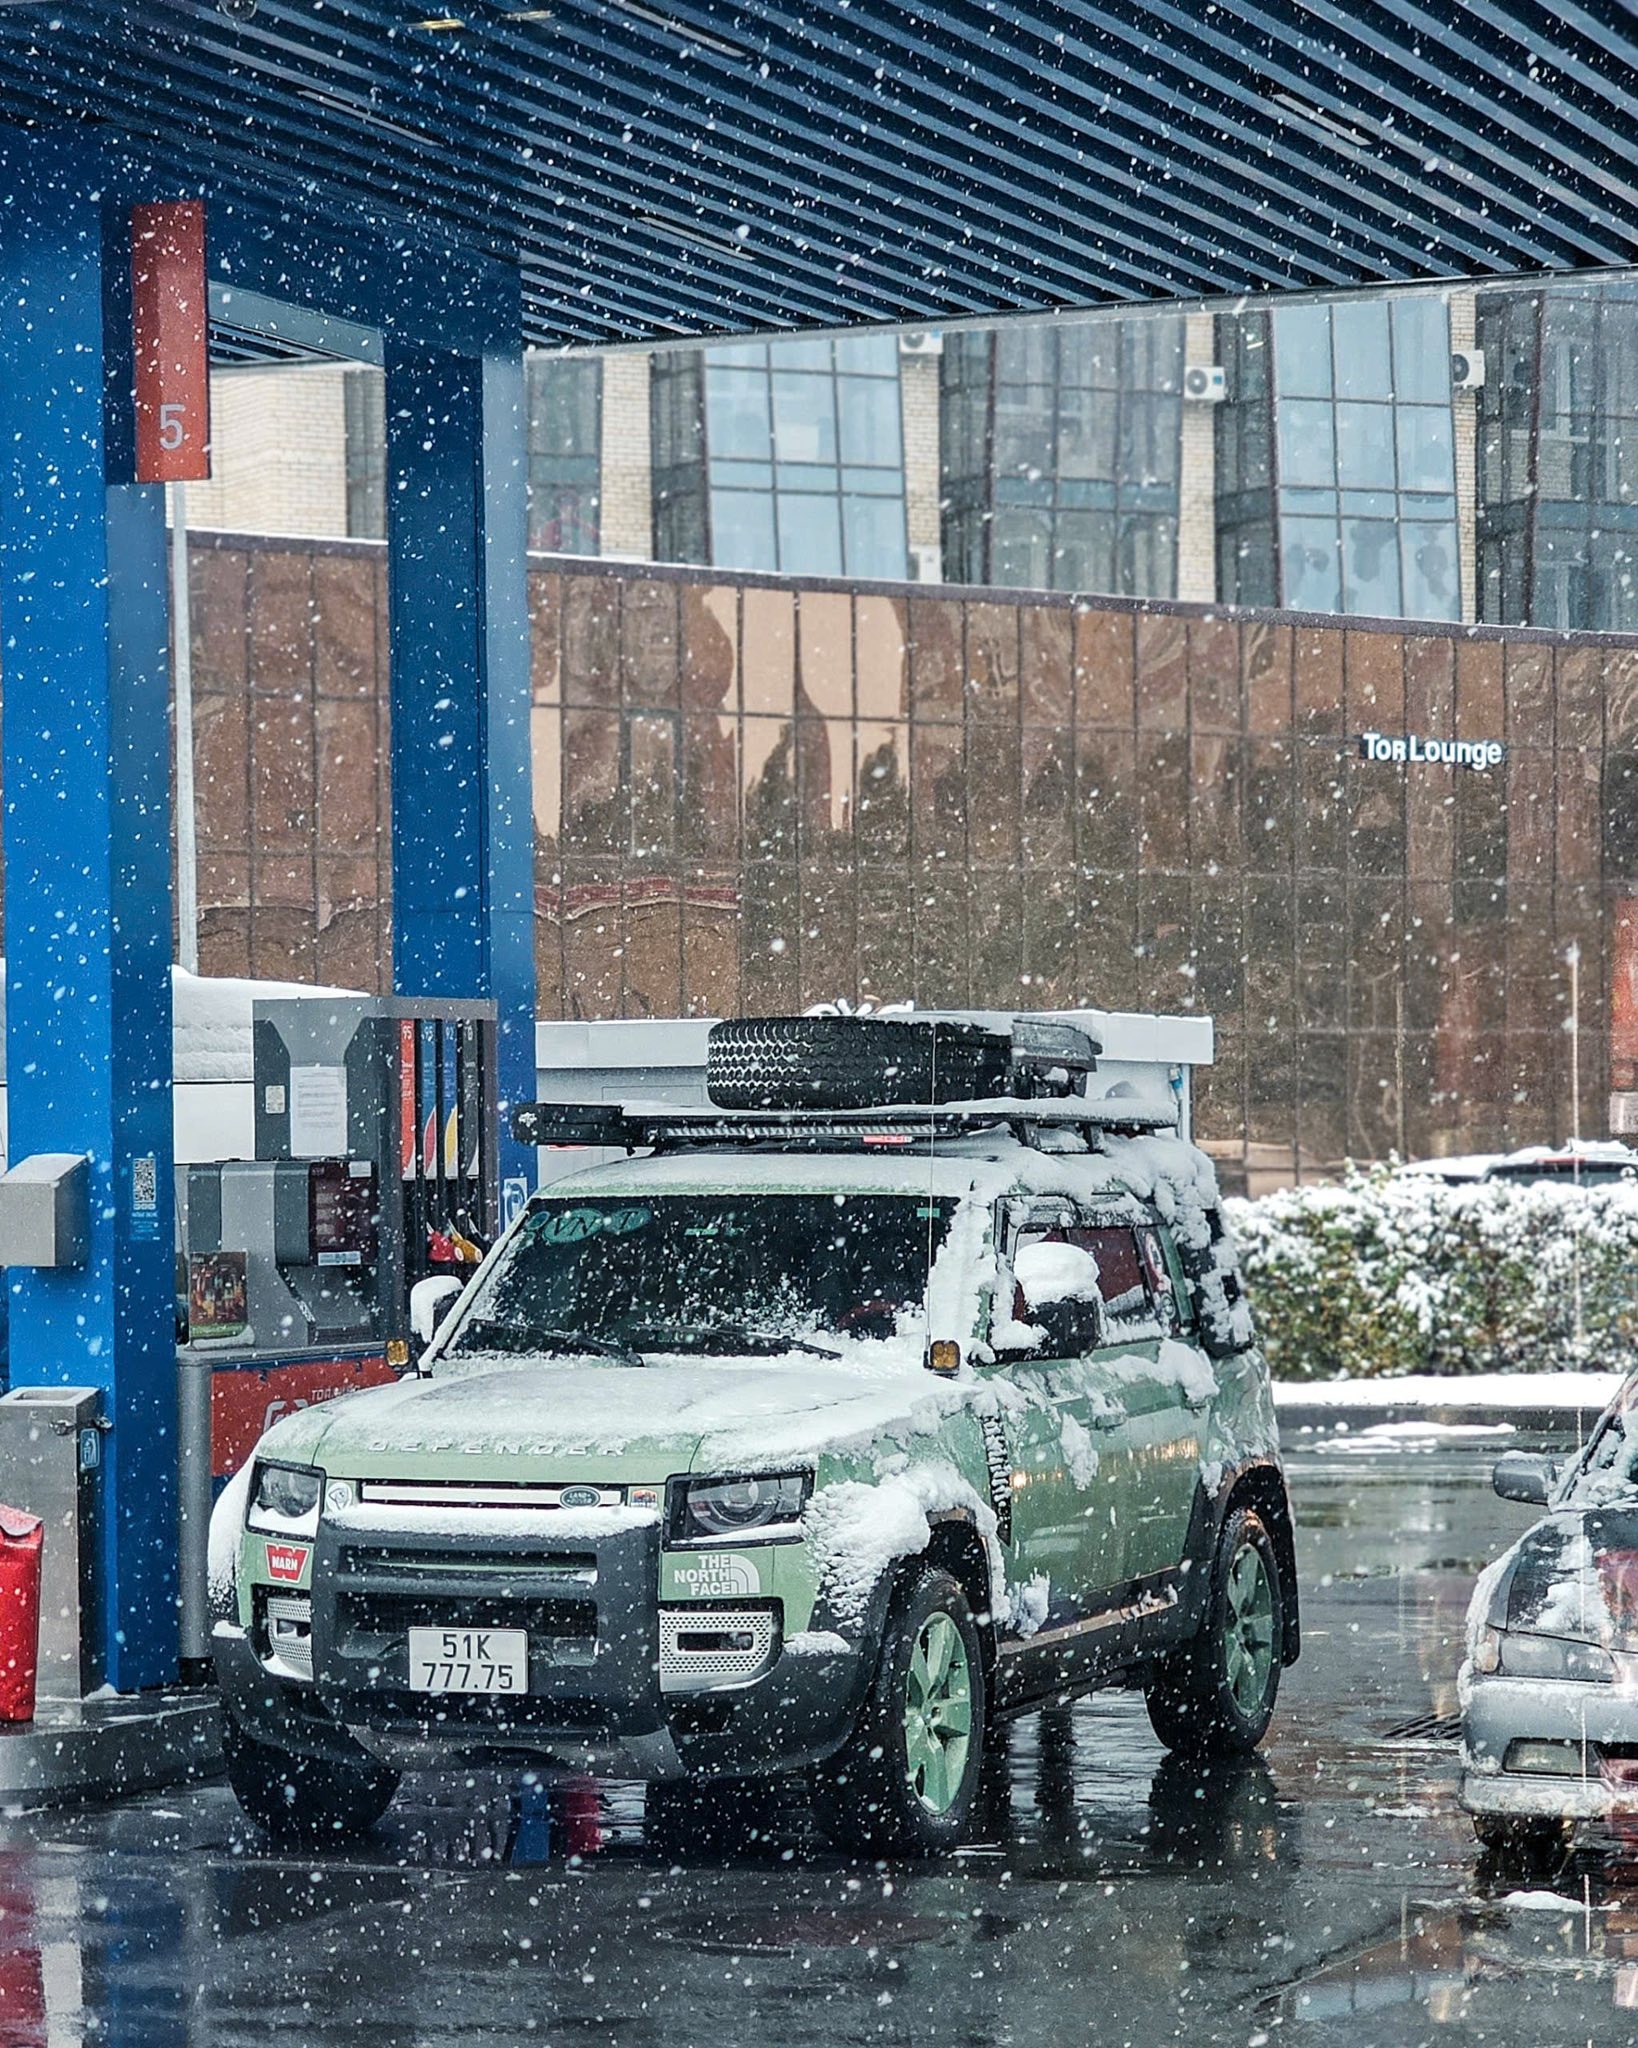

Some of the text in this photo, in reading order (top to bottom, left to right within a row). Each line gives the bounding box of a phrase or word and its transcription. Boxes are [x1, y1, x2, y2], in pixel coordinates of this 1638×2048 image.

[160, 403, 185, 450] 5
[1409, 735, 1502, 771] Lounge
[553, 1216, 599, 1237] VN
[271, 1555, 298, 1571] WARN
[698, 1554, 731, 1569] THE
[674, 1568, 731, 1584] NORTH
[690, 1582, 732, 1596] FACE
[442, 1633, 491, 1660] 51K
[422, 1662, 513, 1690] 777.75
